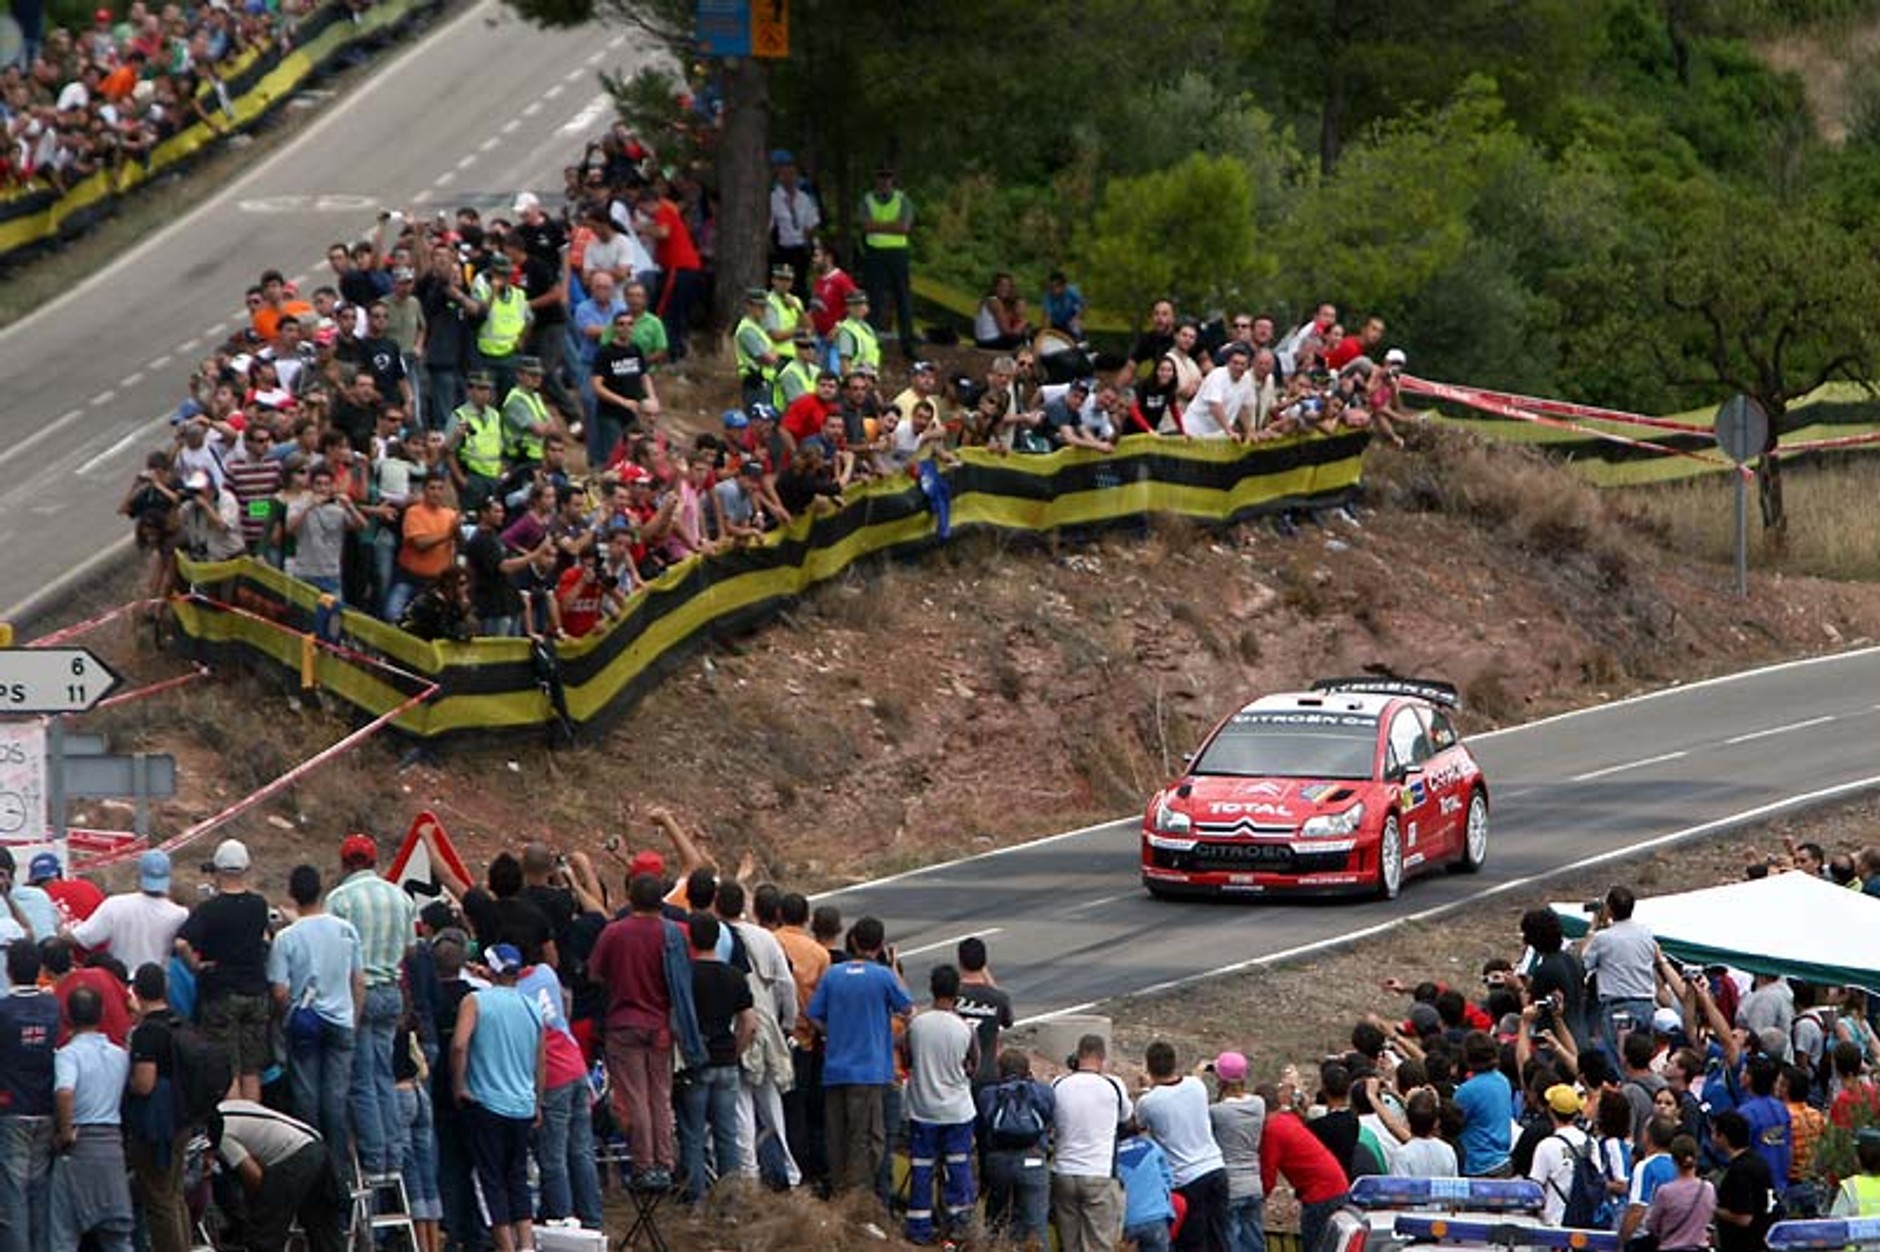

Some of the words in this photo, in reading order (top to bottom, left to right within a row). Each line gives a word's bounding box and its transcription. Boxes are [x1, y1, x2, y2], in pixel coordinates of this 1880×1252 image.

[71, 657, 84, 676] 6
[68, 684, 85, 703] 11
[1208, 801, 1293, 816] TOTAL
